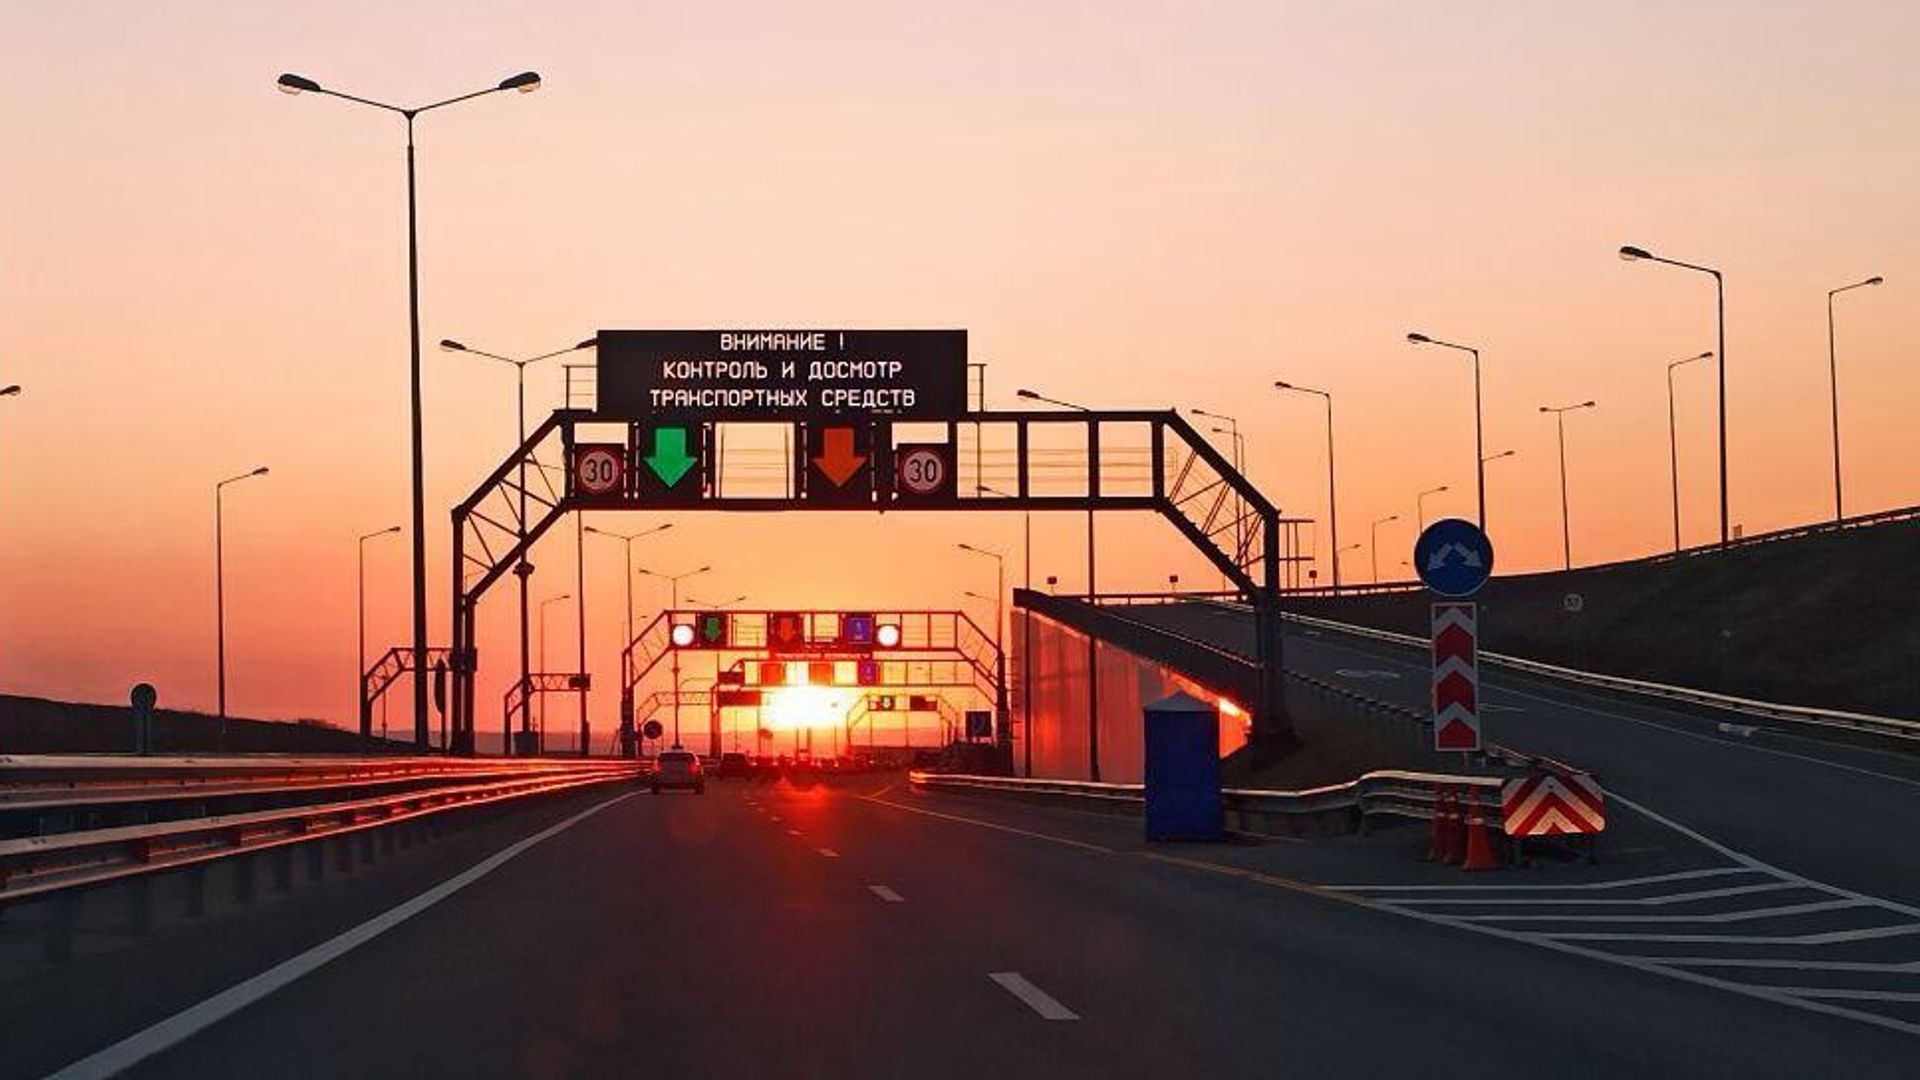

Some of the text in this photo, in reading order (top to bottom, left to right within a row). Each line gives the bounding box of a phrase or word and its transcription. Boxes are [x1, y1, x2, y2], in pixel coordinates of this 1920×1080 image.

[720, 332, 826, 351] ВНИМАНИЕ
[663, 361, 903, 381] КОНТРОЛЬ И ДОСМОТР
[649, 389, 915, 409] ТРАНСПОРТНЫХ СРЕДСТВ
[585, 459, 613, 482] 30
[909, 459, 937, 482] 30
